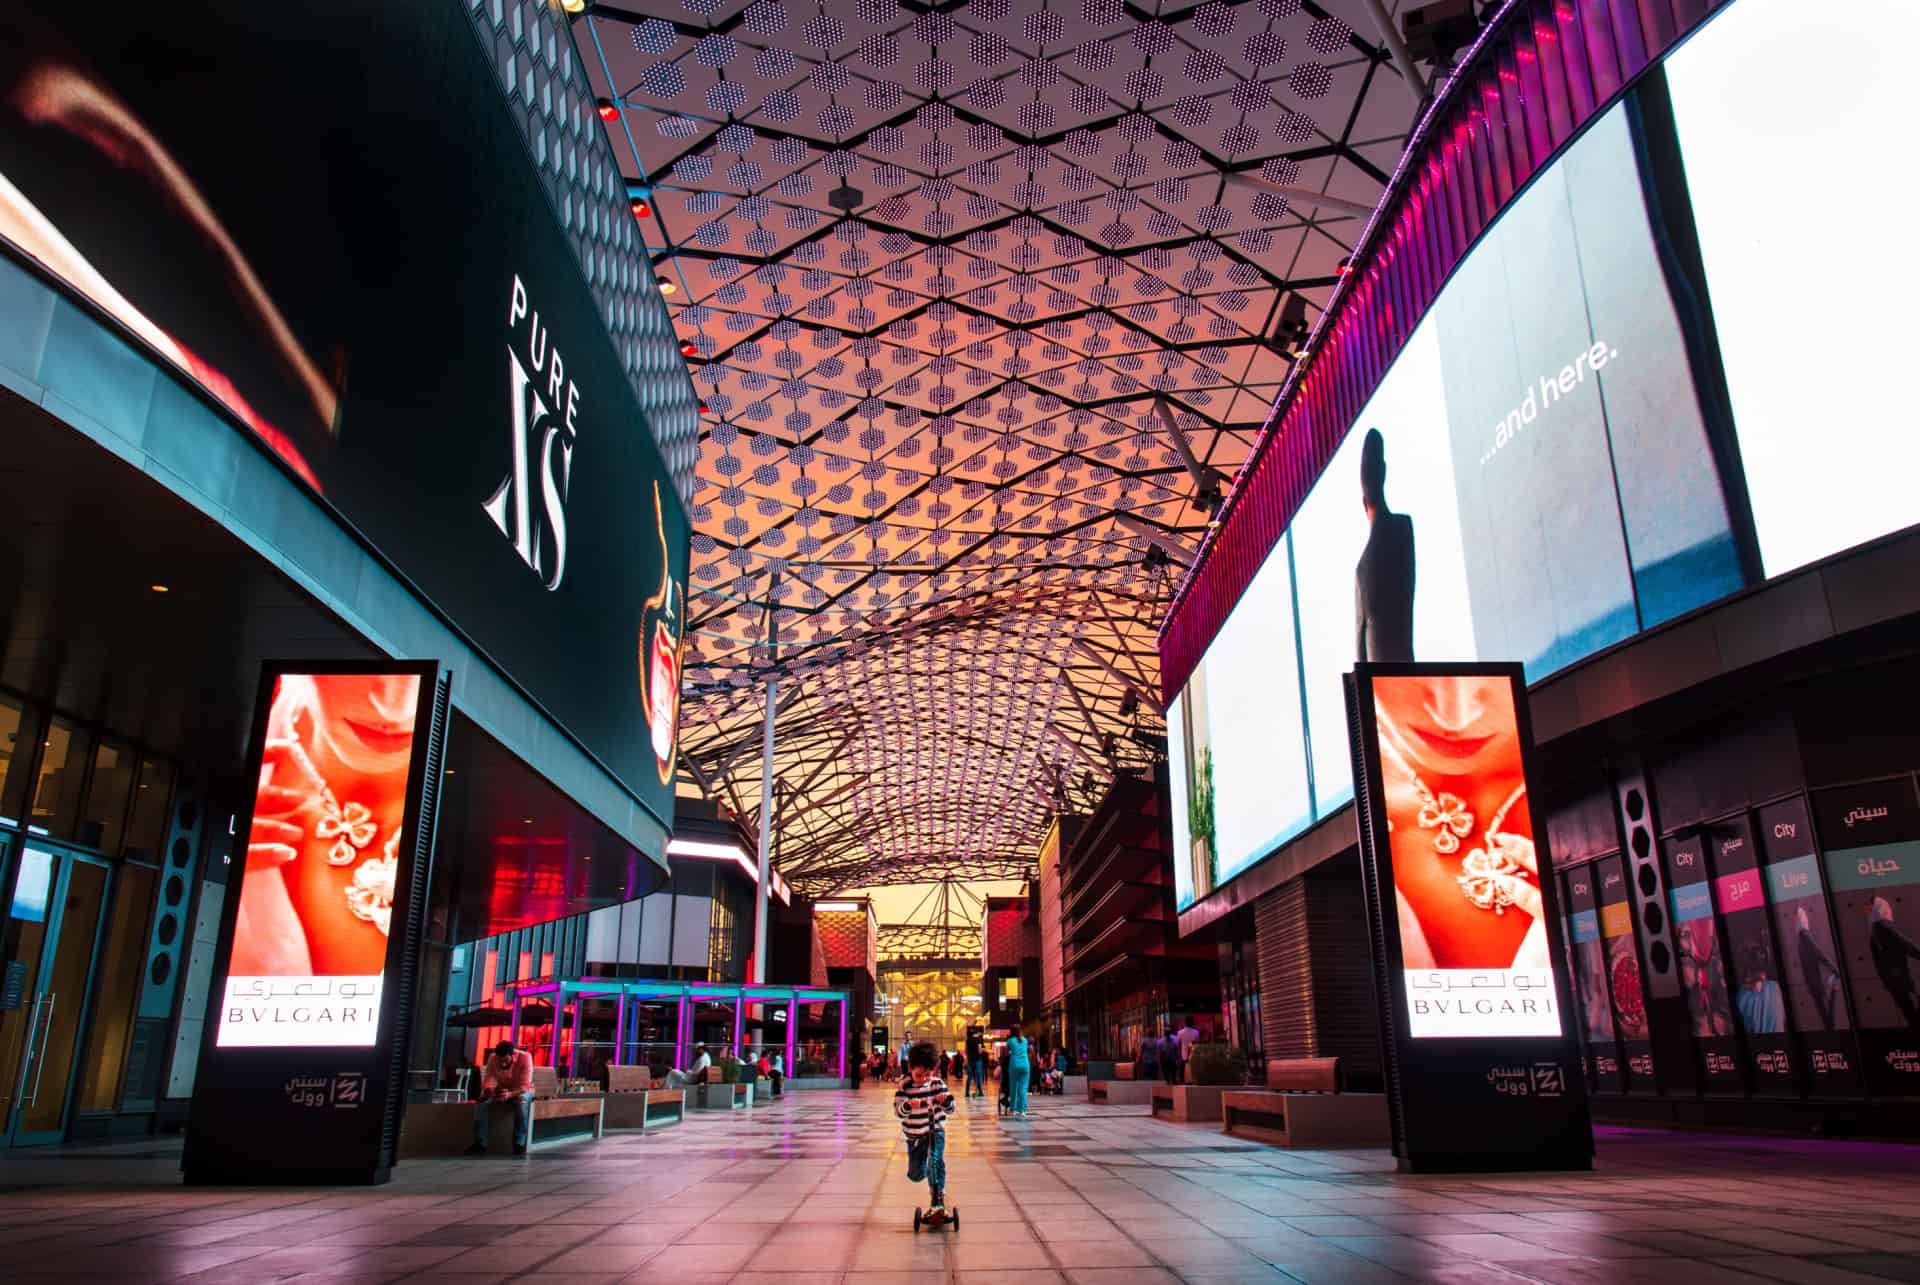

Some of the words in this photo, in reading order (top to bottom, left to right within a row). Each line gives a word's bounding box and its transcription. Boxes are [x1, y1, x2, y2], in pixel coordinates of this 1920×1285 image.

[509, 272, 580, 438] PURE
[1539, 340, 1618, 409] here.
[1843, 805, 1889, 827] سيتي
[1774, 823, 1797, 838] City
[1676, 852, 1695, 867] City
[1781, 871, 1809, 889] Live
[227, 1007, 373, 1024] BVLGARI
[1414, 999, 1553, 1015] BVLGARI
